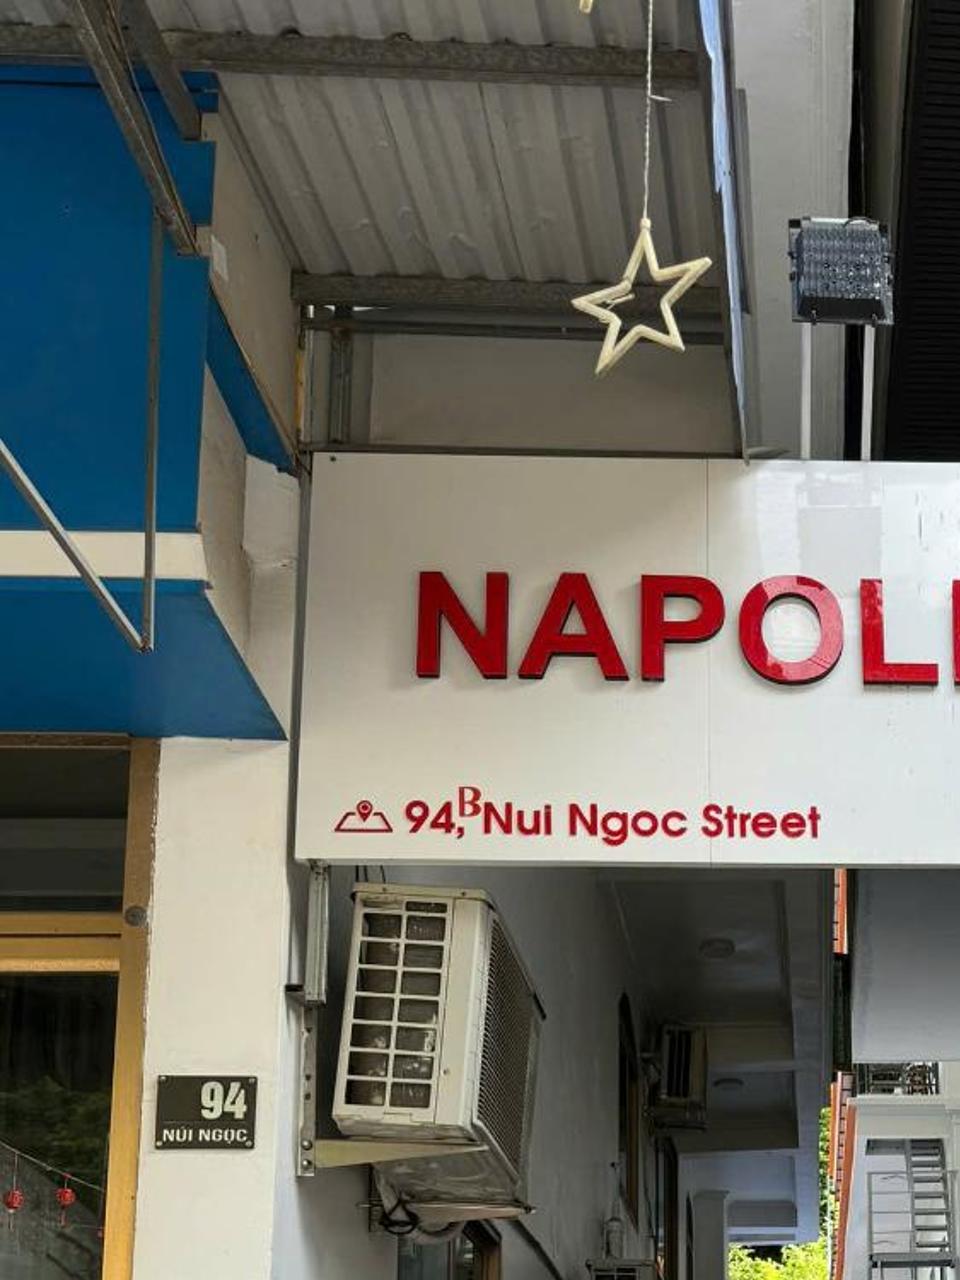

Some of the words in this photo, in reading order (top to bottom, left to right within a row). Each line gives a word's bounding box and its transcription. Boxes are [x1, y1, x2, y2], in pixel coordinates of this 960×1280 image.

[483, 801, 552, 835] Nui
[568, 803, 687, 846] Ngoc
[701, 804, 821, 838] Street
[201, 1081, 247, 1119] 94
[163, 1126, 193, 1142] NÚI
[198, 1128, 247, 1145] NGỌC
